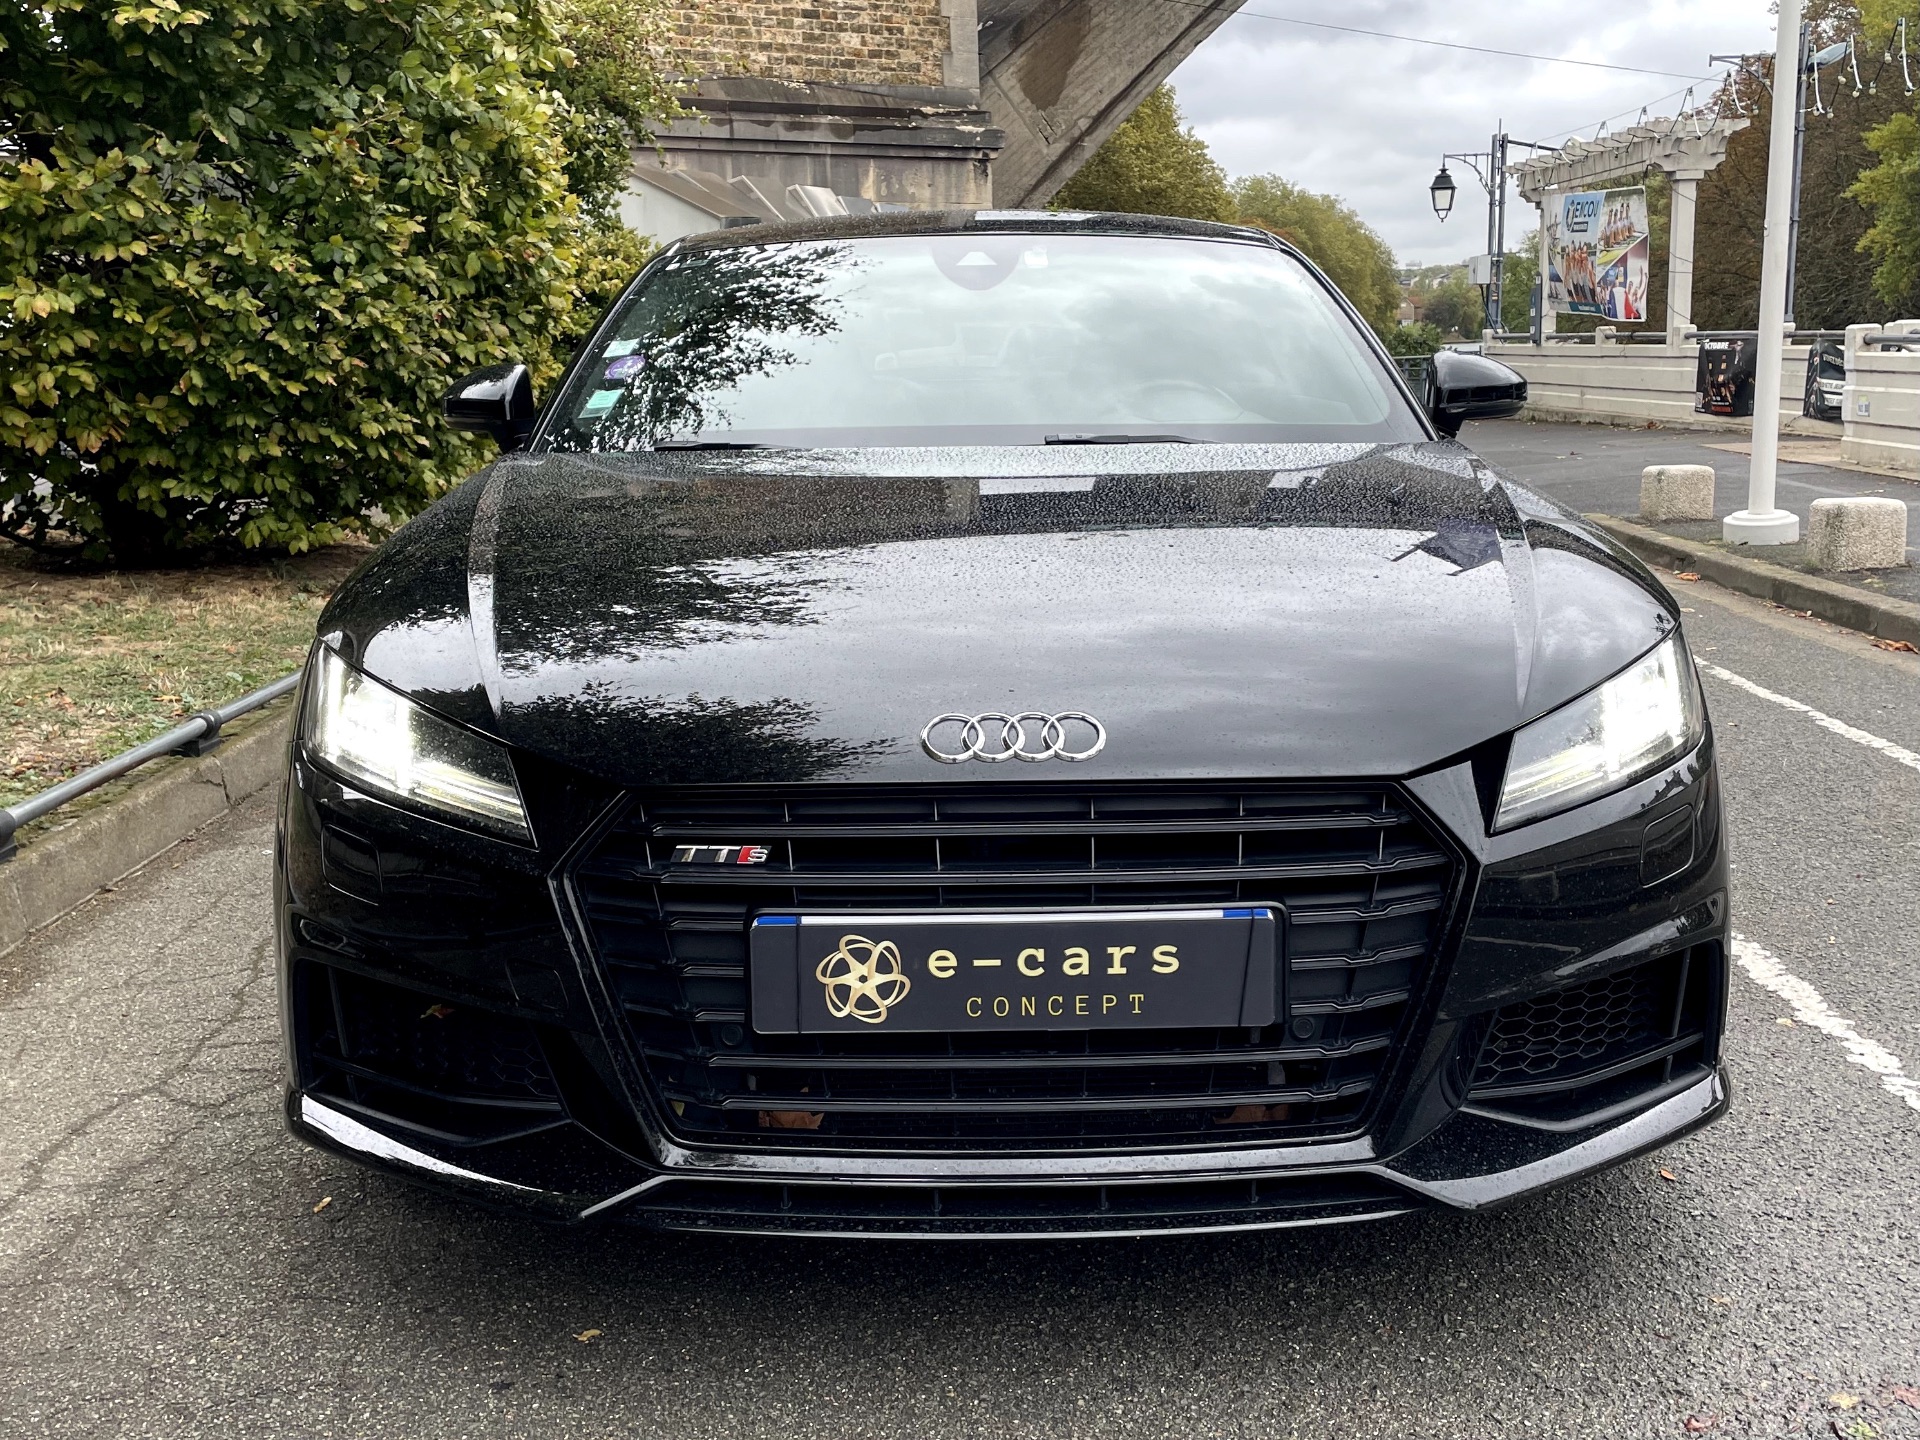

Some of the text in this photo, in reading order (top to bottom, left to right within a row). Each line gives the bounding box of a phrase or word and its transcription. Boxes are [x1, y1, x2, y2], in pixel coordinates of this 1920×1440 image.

[675, 845, 769, 864] TTS
[928, 943, 1181, 979] e-cars
[966, 994, 1146, 1018] CONCEPT
